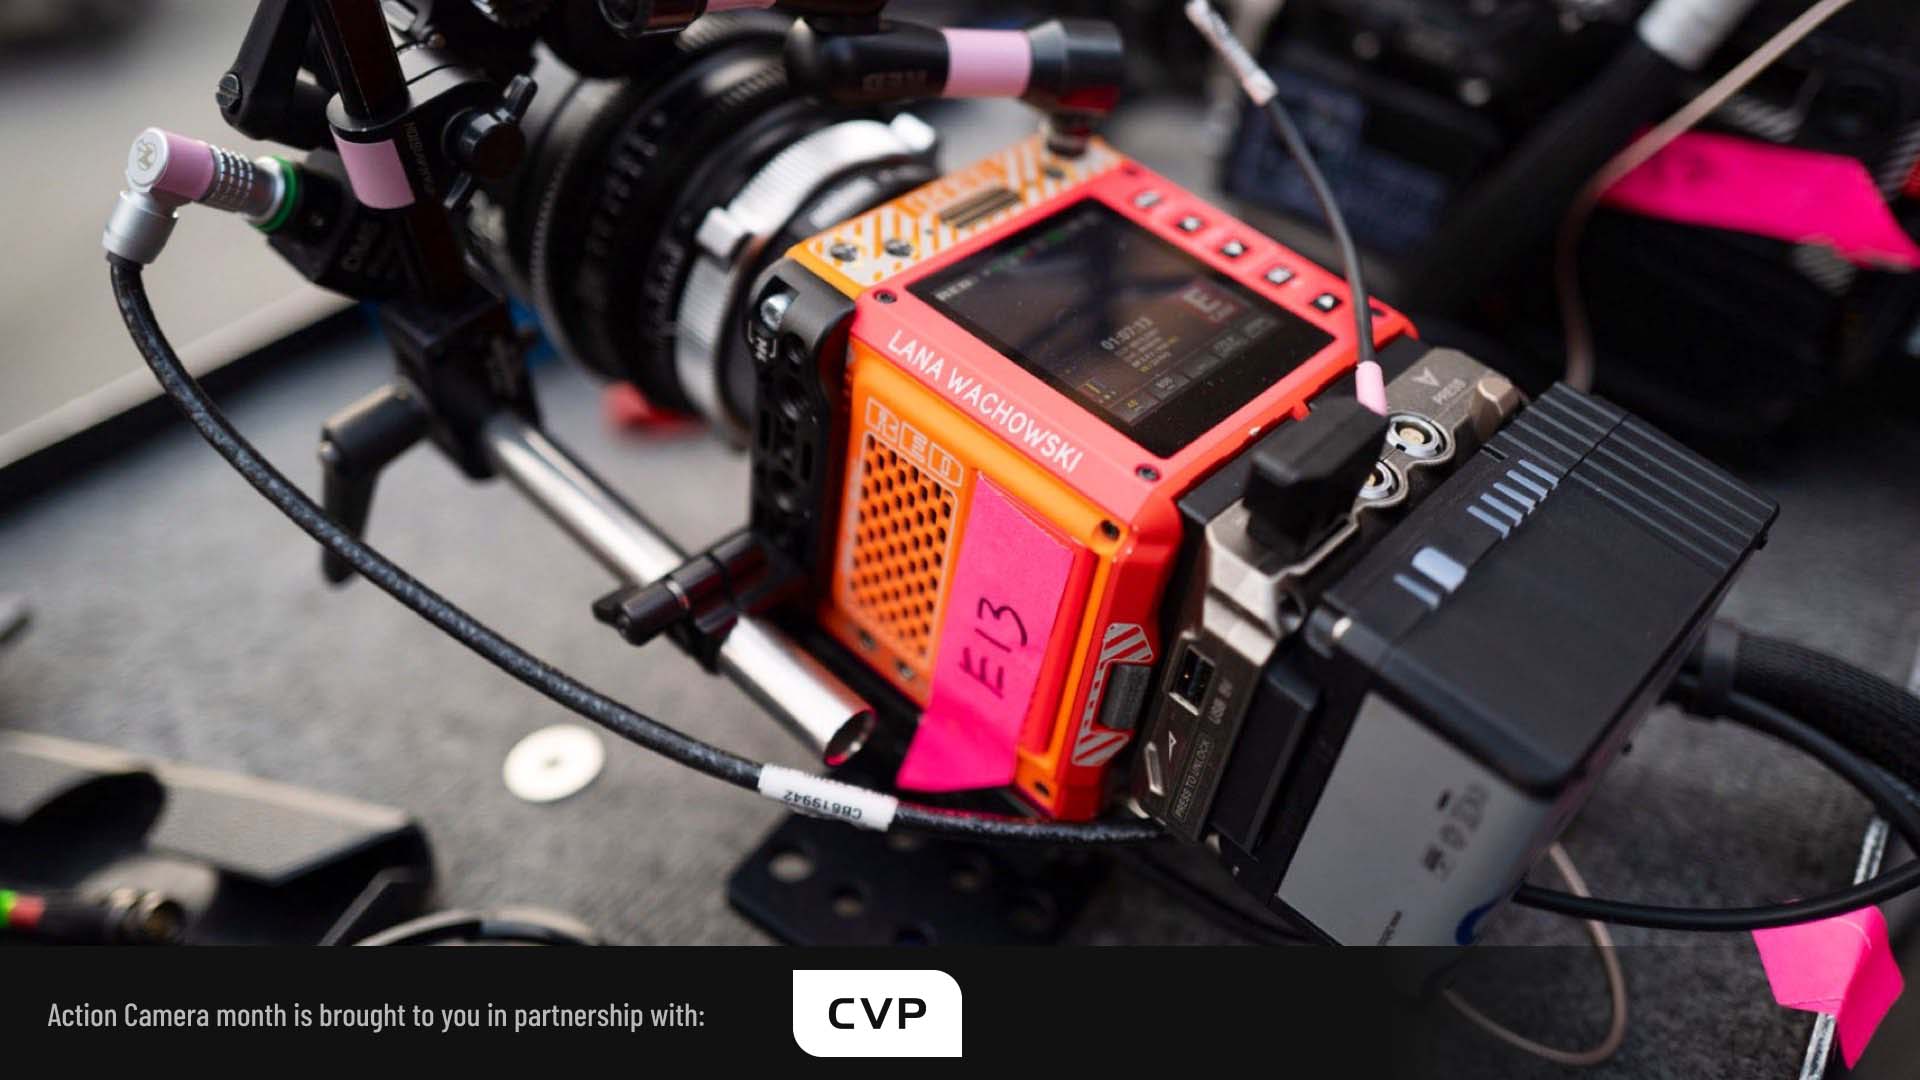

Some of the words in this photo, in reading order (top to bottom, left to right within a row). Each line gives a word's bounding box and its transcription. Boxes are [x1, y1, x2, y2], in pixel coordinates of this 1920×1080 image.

[887, 328, 945, 381] LANA
[946, 367, 1085, 474] WACHOWSKI
[958, 597, 1028, 700] E13
